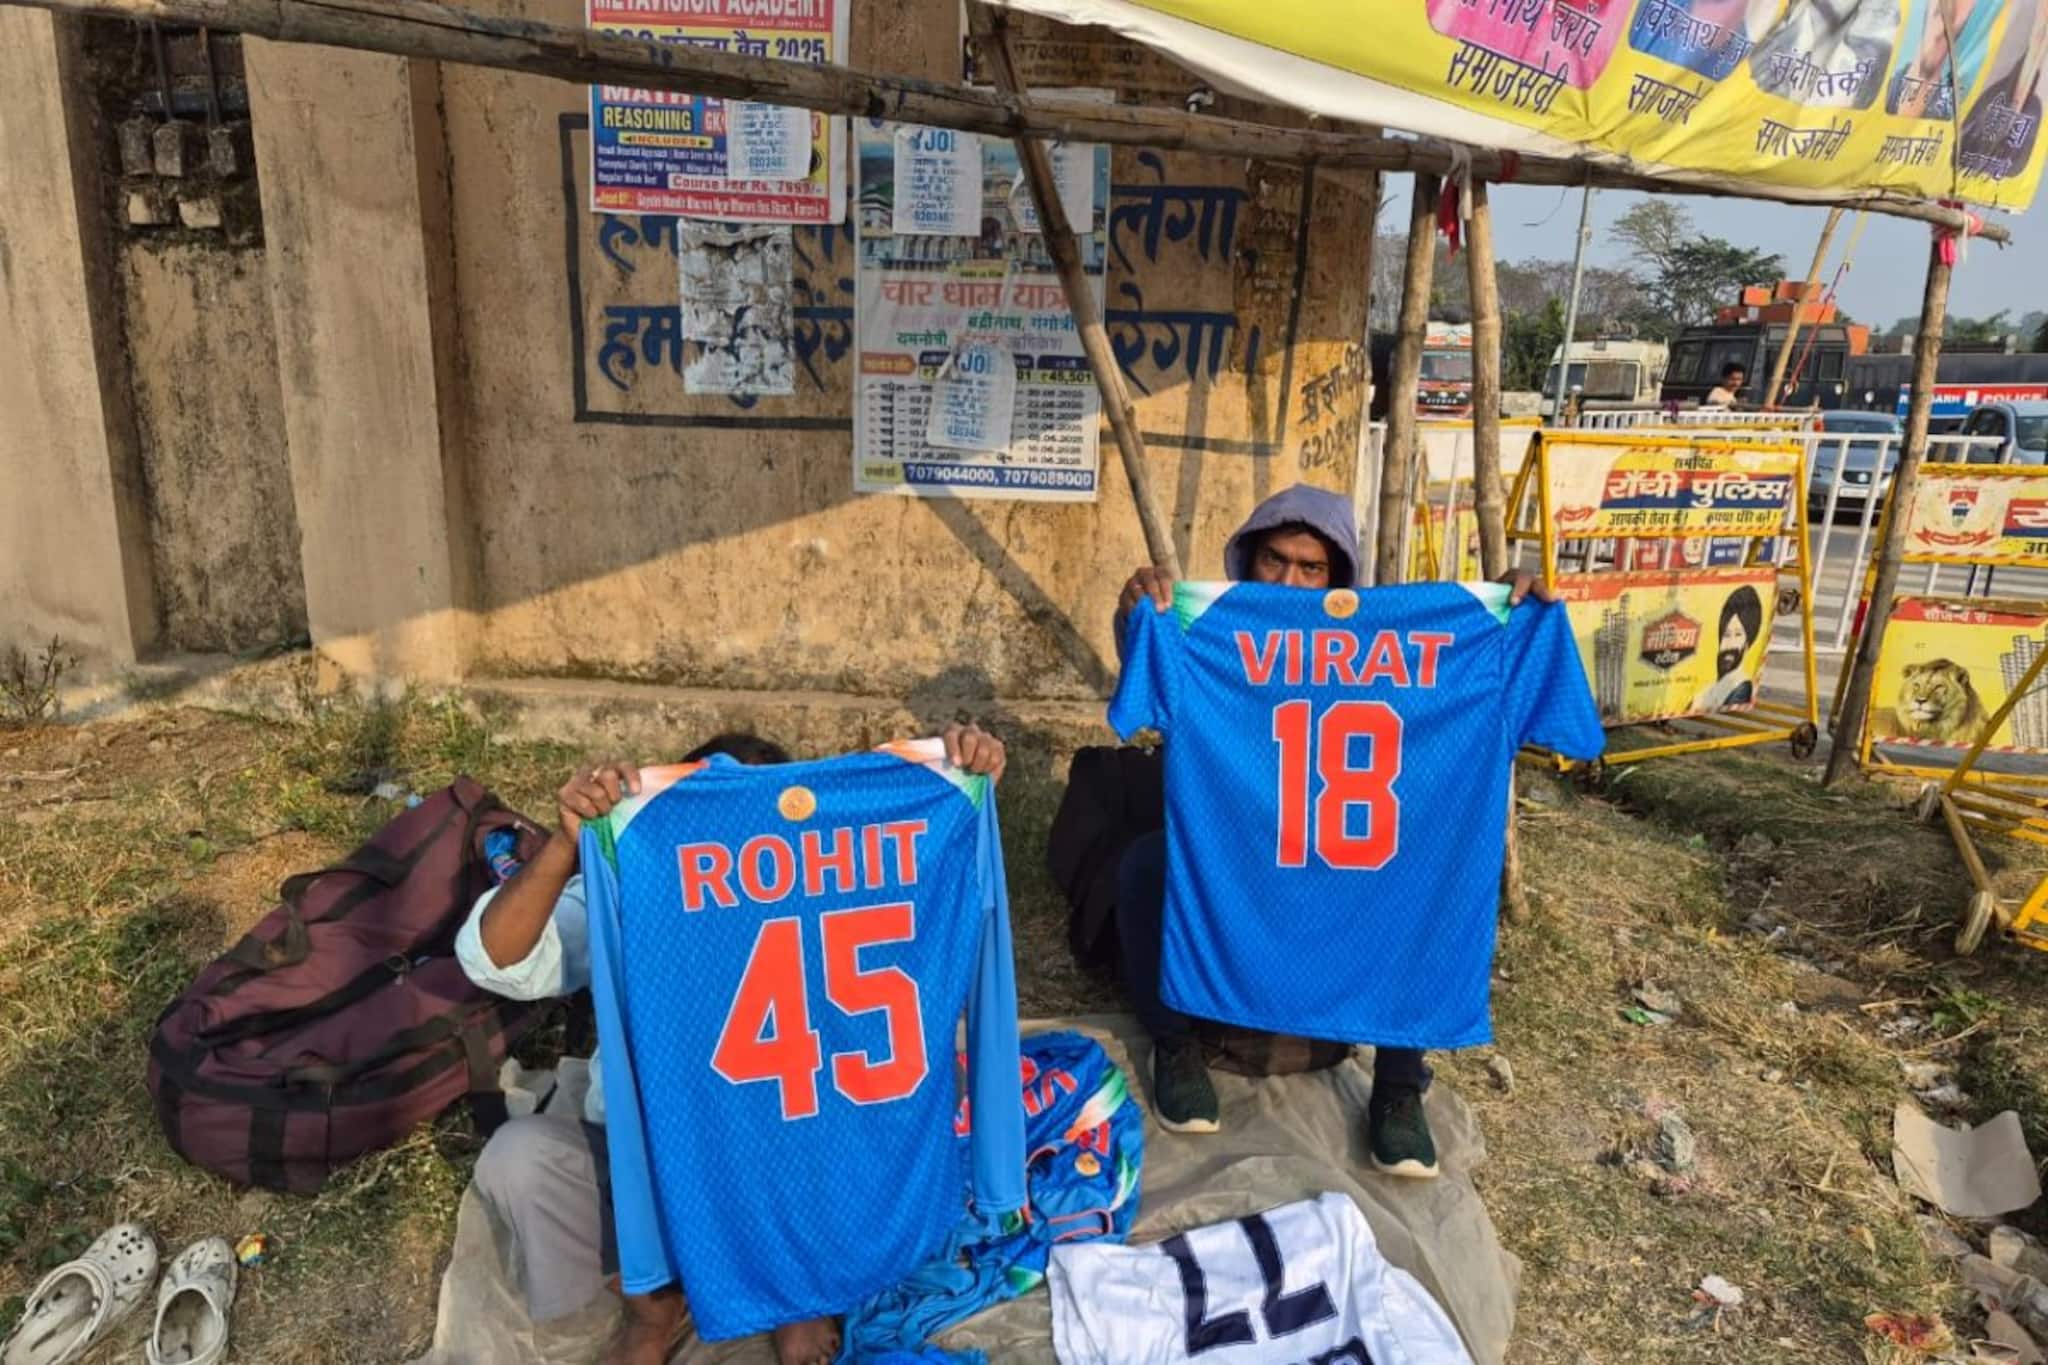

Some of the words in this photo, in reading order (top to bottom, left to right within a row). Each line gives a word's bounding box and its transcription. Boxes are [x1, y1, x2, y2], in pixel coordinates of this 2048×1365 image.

[775, 37, 826, 64] 2025
[603, 106, 692, 131] REASONING
[672, 175, 719, 192] Course
[750, 177, 772, 193] Rs.
[883, 279, 936, 307] चार
[943, 281, 1004, 308] धाम
[1690, 472, 1788, 508] पुलिस
[1234, 629, 1455, 687] VIRAT
[1272, 699, 1403, 871] 18
[677, 819, 928, 912] ROHIT
[709, 901, 929, 1121] 45
